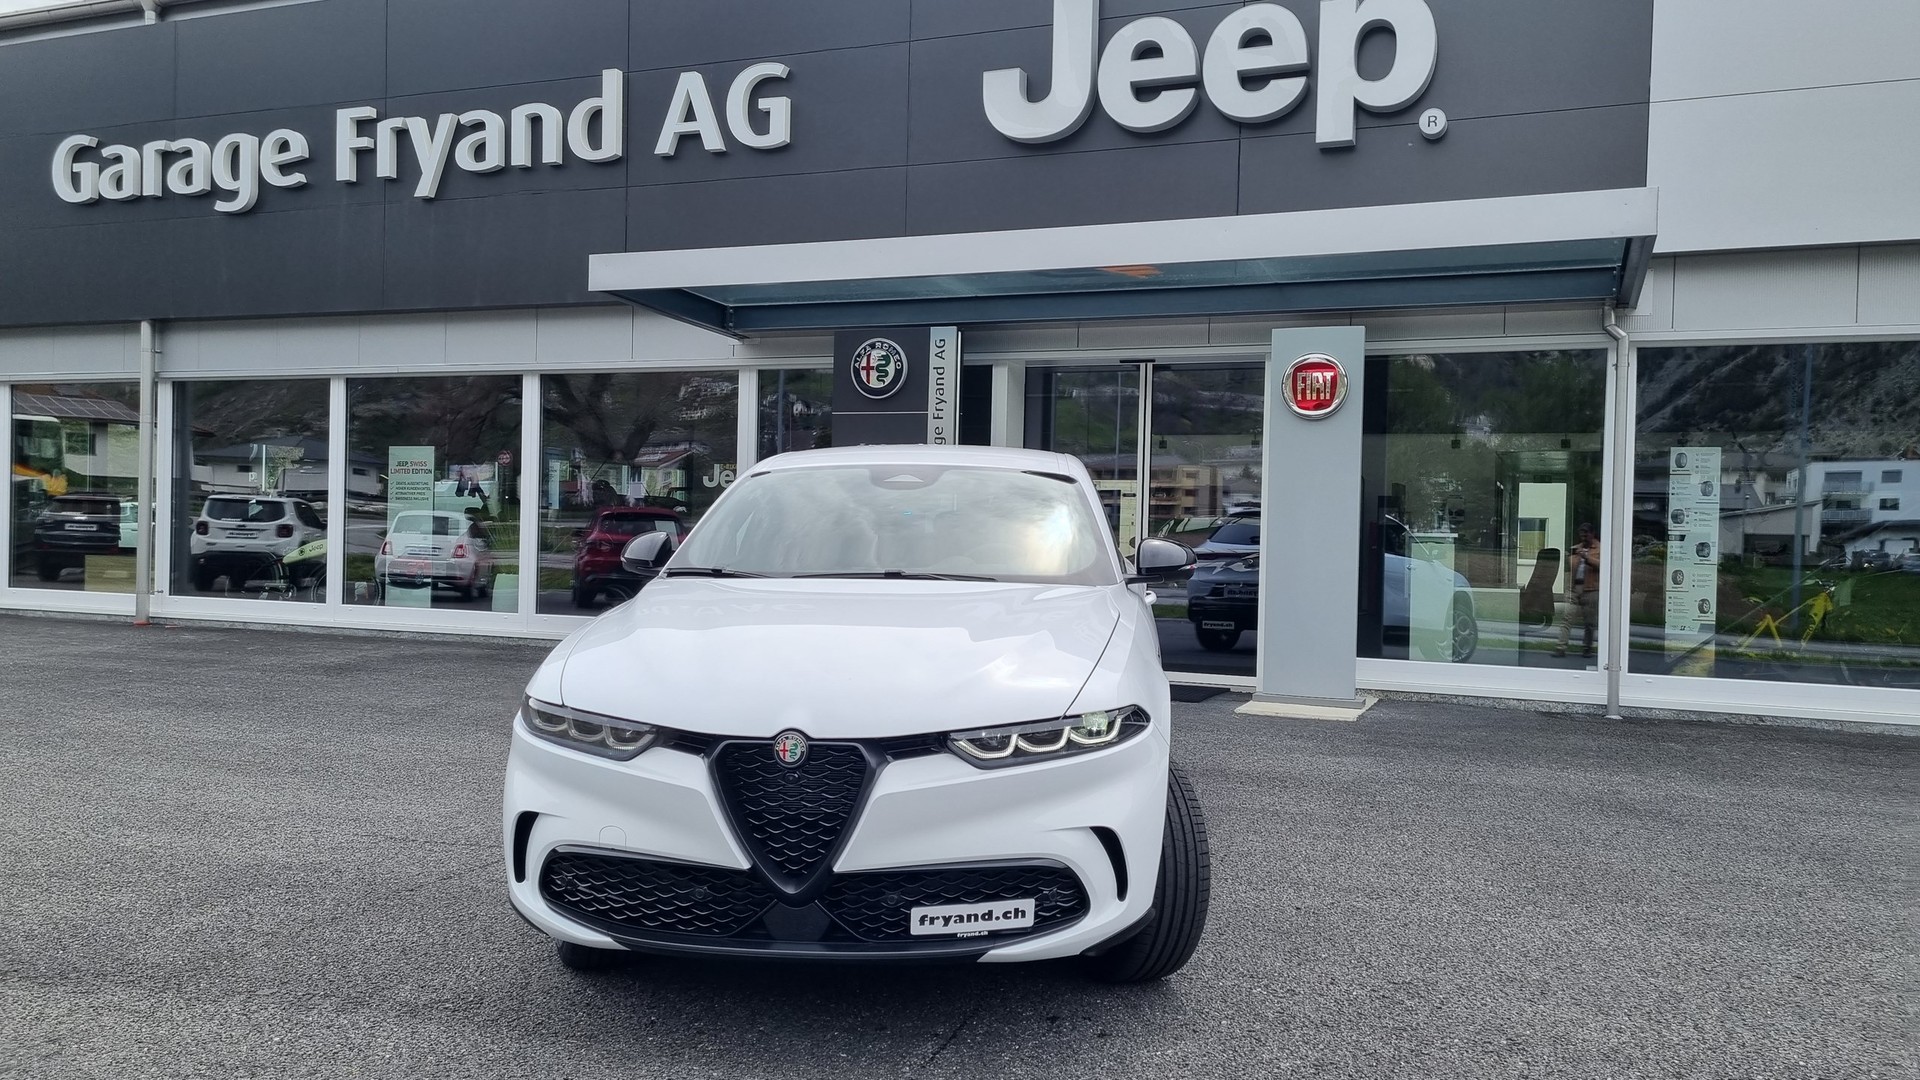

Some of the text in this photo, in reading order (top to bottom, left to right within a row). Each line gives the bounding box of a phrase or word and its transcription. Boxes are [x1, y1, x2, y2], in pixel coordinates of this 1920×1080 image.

[983, 0, 1438, 150] Jeep
[52, 62, 792, 214] Garage Fryand AG
[855, 341, 902, 370] ALFA ROMEO
[935, 338, 946, 360] AG
[933, 366, 947, 420] Fryand
[1297, 371, 1335, 400] FIAT
[918, 907, 1027, 928] fryand.ch
[956, 930, 989, 938] fryand.ch
